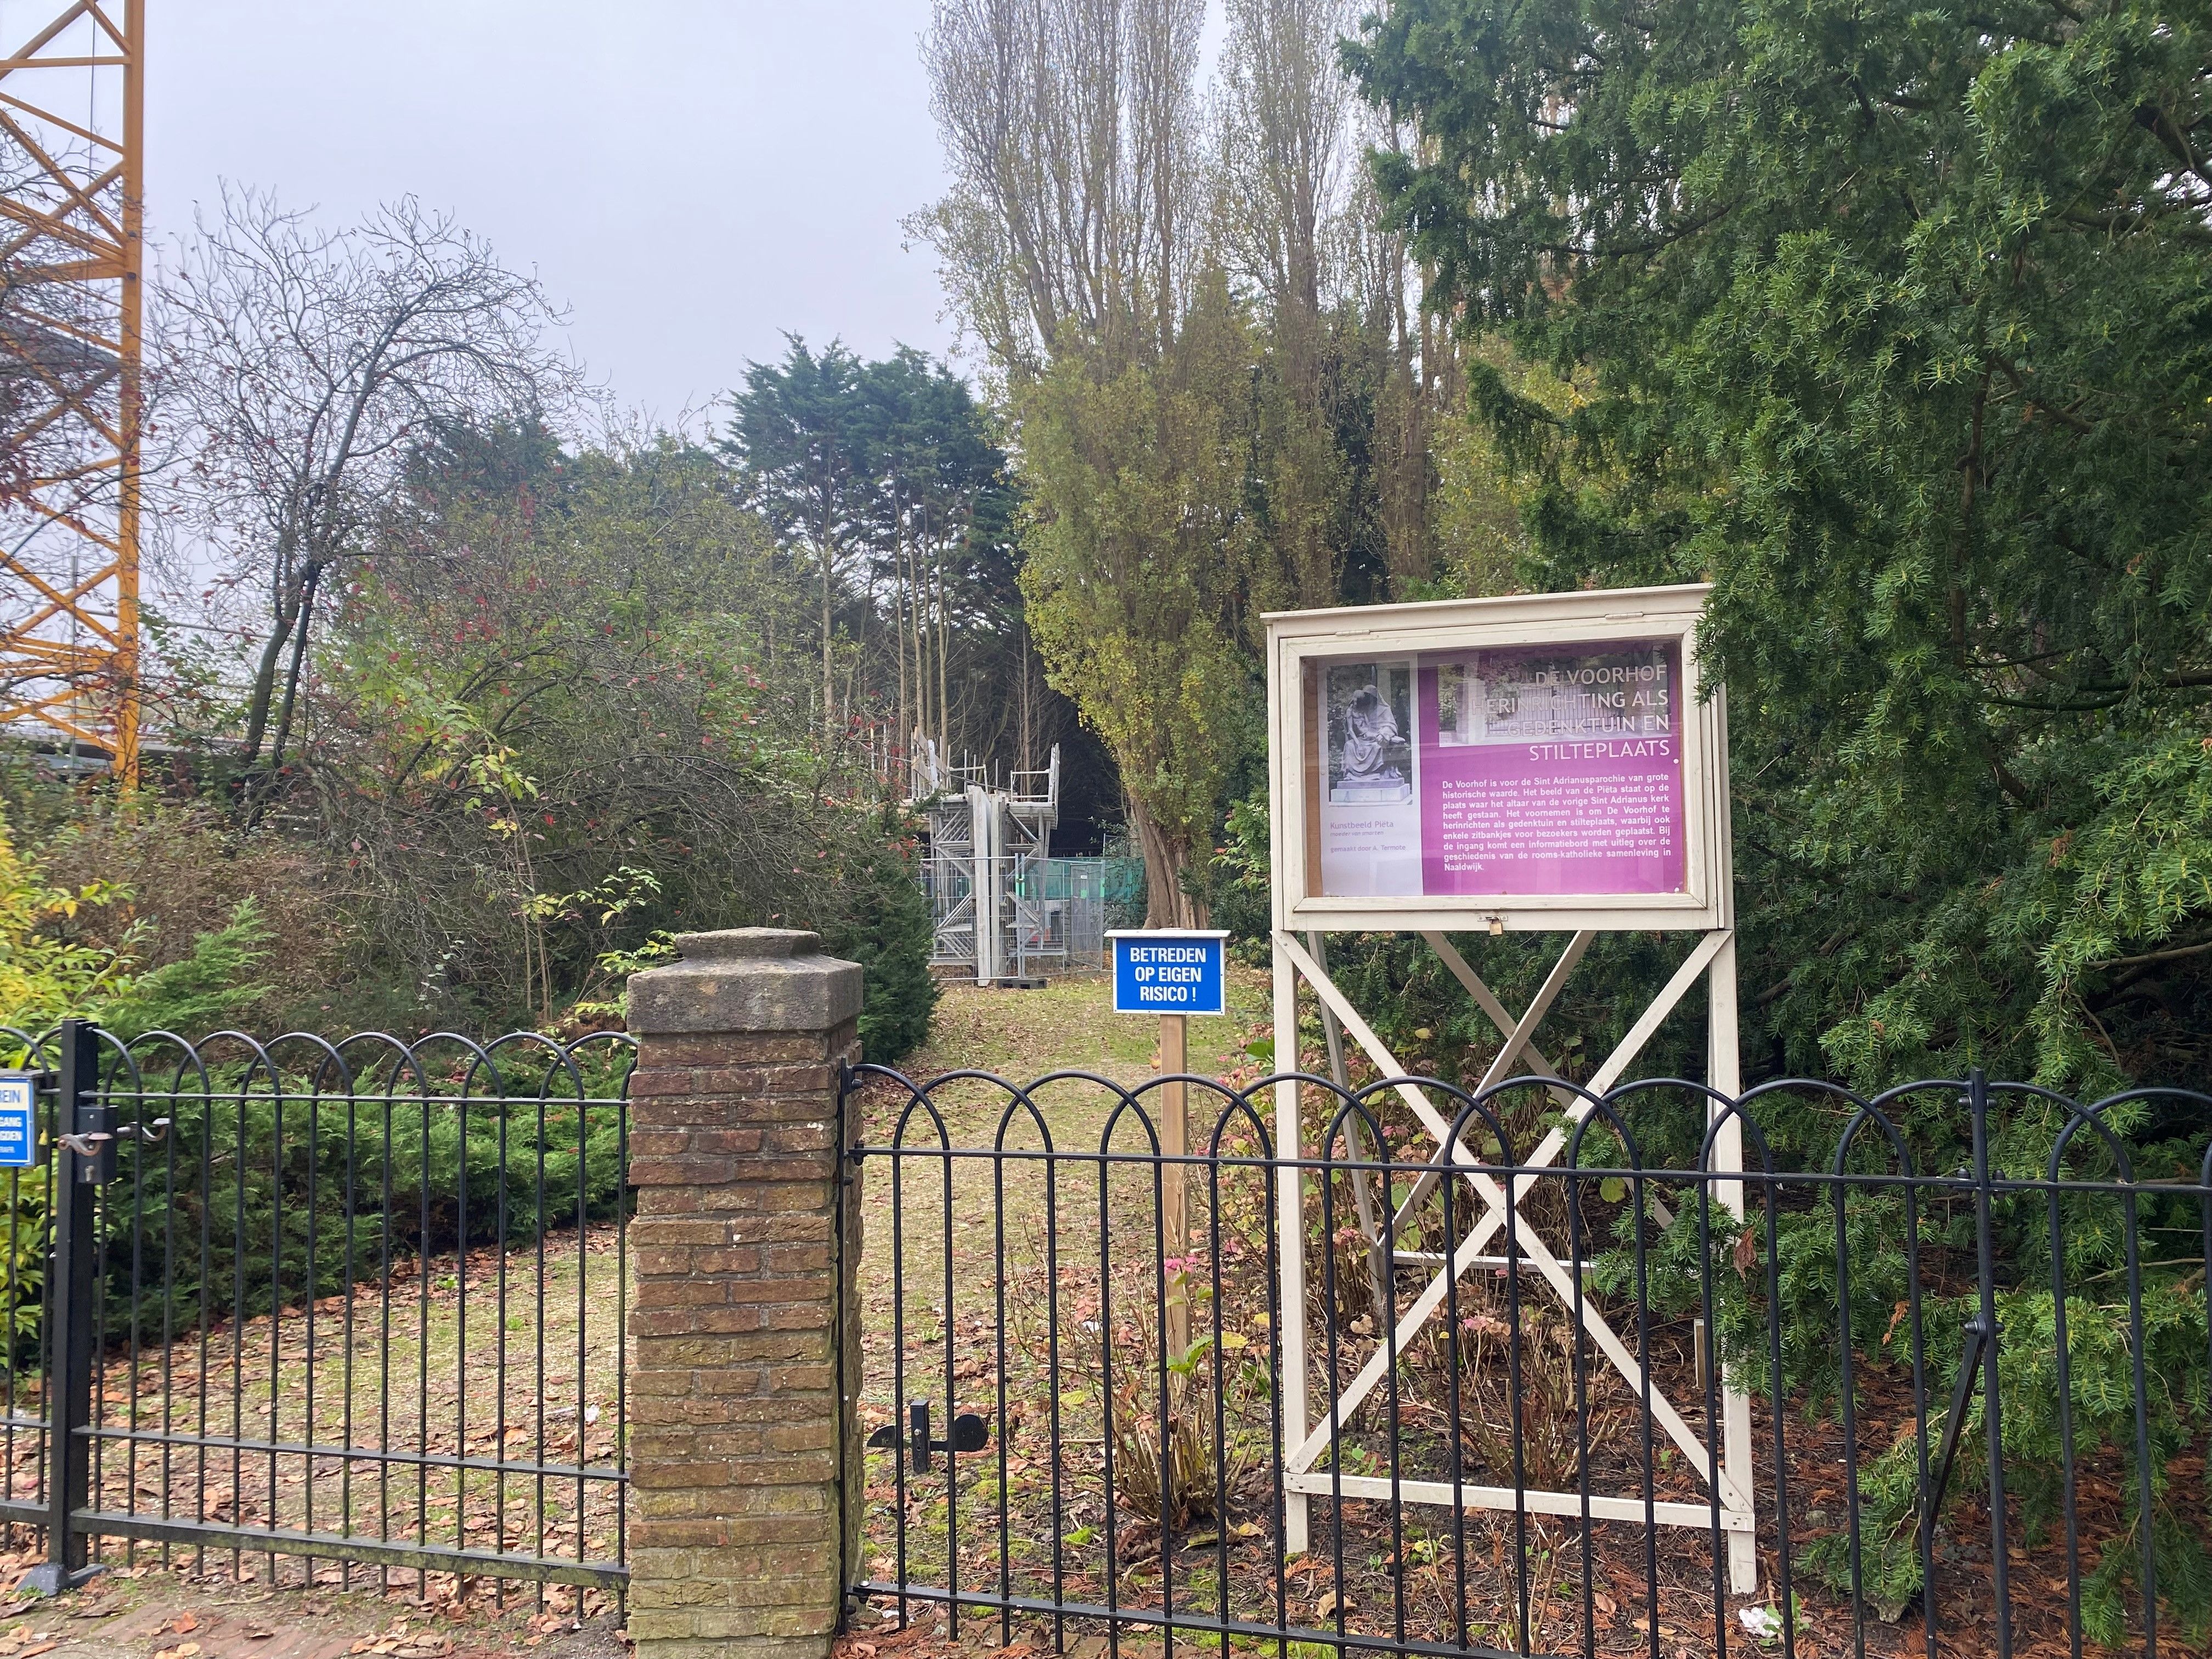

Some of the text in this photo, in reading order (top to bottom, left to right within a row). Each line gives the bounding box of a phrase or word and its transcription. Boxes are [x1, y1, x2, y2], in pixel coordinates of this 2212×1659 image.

[1536, 664, 1667, 686] DE VOORHOF
[1472, 689, 1668, 714] HERINRICHTING ALS
[1508, 714, 1669, 737] GEDENKTUIN EN
[1530, 740, 1670, 761] STILTEPLAATS
[1442, 781, 1453, 789] De
[1456, 779, 1487, 788] Voorhof
[1553, 775, 1626, 785] Adrianusparochie
[1647, 773, 1669, 783] grote
[1443, 790, 1486, 799] historische
[1489, 789, 1520, 797] waarde.
[1541, 787, 1562, 795] beeld
[1597, 785, 1617, 793] Piëta
[1443, 802, 1466, 811] plaats
[1562, 797, 1588, 806] vorige
[1591, 796, 1607, 804] Sint
[1610, 795, 1647, 804] Adrianus
[1468, 811, 1501, 820] gestaan.
[1607, 806, 1618, 815] De
[1623, 805, 1657, 814] Voorhof
[1443, 821, 1490, 830] herinrichten
[1509, 819, 1554, 829] gedenktuin
[1571, 817, 1617, 827] stilteplaats,
[1621, 816, 1651, 826] waarbij
[1655, 815, 1670, 823] ook
[1443, 832, 1469, 840] enkele
[1471, 831, 1511, 840] zitbankjes
[1537, 828, 1578, 837] bezoekers
[1581, 828, 1611, 836] worden
[1615, 827, 1655, 837] geplaatst.
[1659, 826, 1671, 836] Bij
[1457, 842, 1483, 851] ingang
[1529, 839, 1588, 848] informatiebord
[1611, 838, 1634, 848] uitleg
[1660, 837, 1671, 845] de
[1444, 851, 1496, 862] geschiedenis
[1532, 850, 1602, 859] rooms-katholieke
[1606, 848, 1659, 858] samenleving
[1444, 862, 1484, 872] Naaldwijk.
[1130, 947, 1206, 963] BETREDEN
[1135, 966, 1201, 982] OP EIGEN
[1140, 986, 1187, 1002] RISICO
